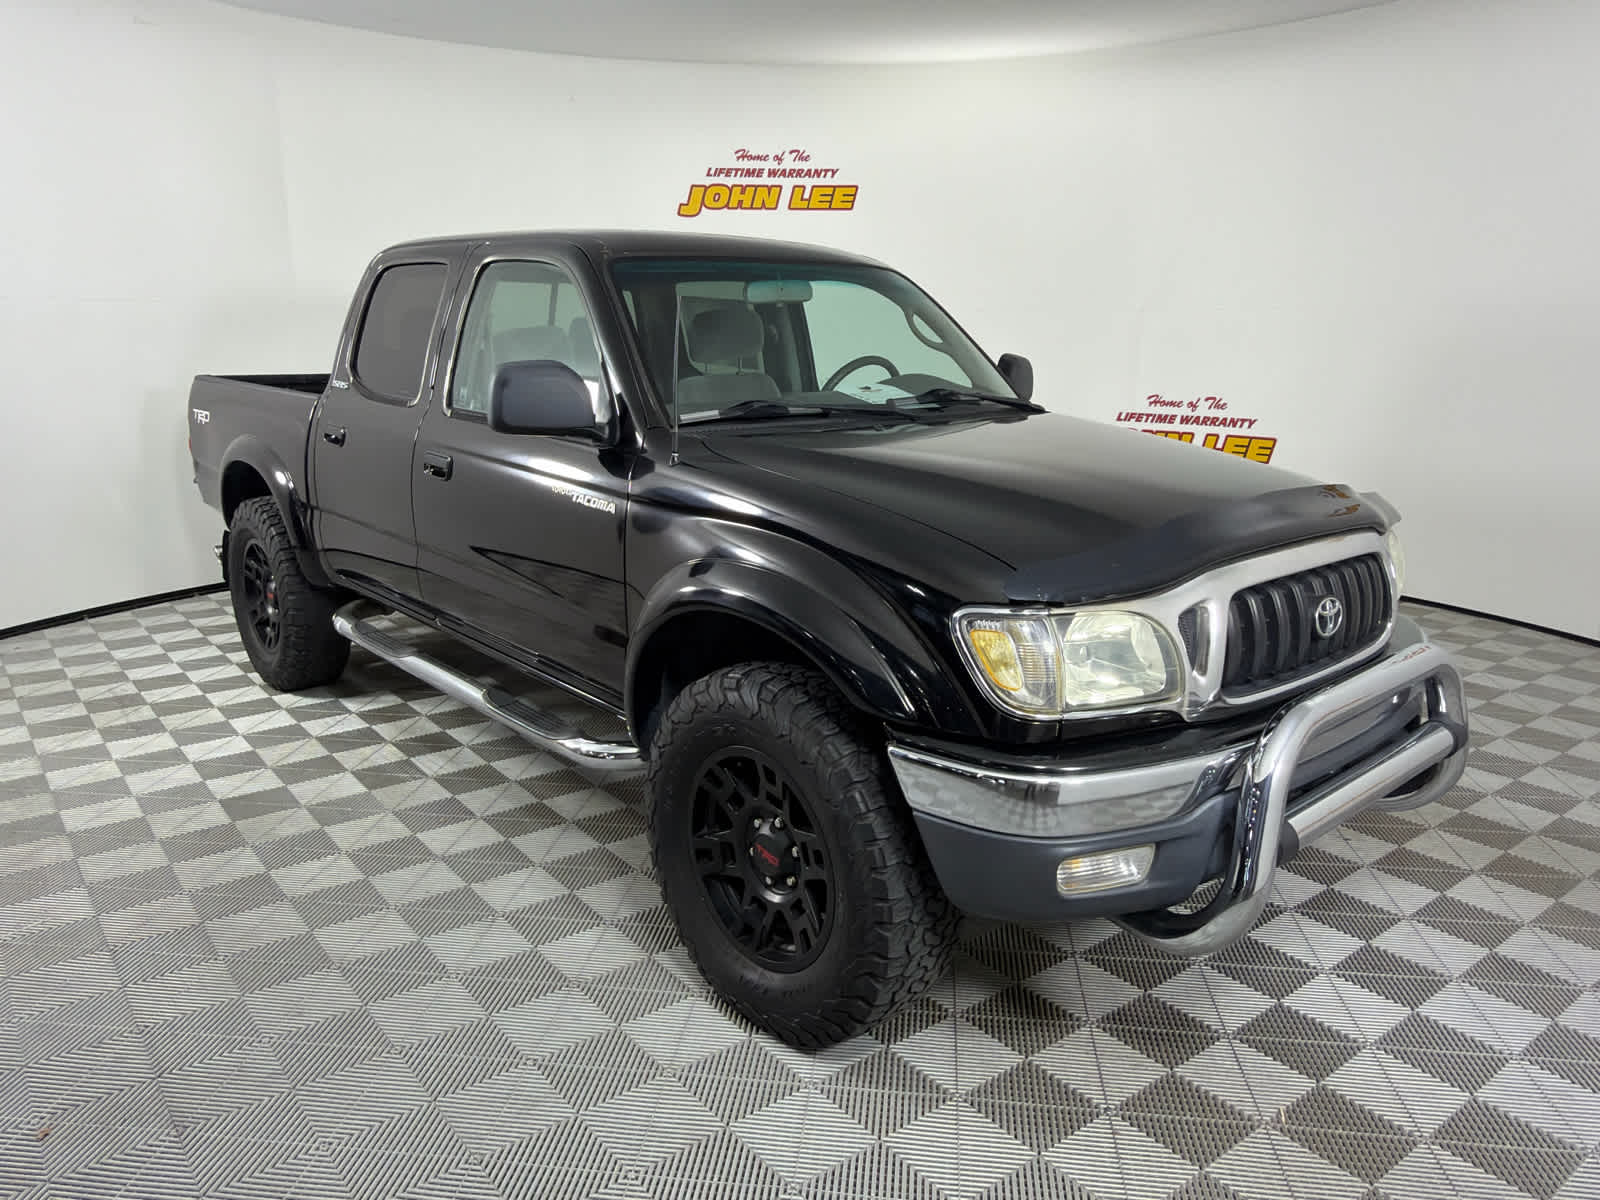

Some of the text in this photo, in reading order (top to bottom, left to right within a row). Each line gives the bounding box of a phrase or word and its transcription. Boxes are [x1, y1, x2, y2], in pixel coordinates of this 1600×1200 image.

[734, 148, 811, 165] Home of The
[706, 167, 840, 179] LIFETIME WARRANTY
[677, 183, 859, 218] JOHN LEE
[1146, 394, 1229, 412] Home of The
[1116, 411, 1259, 429] LIFETIME WARRANTY
[1202, 433, 1278, 465] LEE
[572, 492, 616, 514] TACOMA
